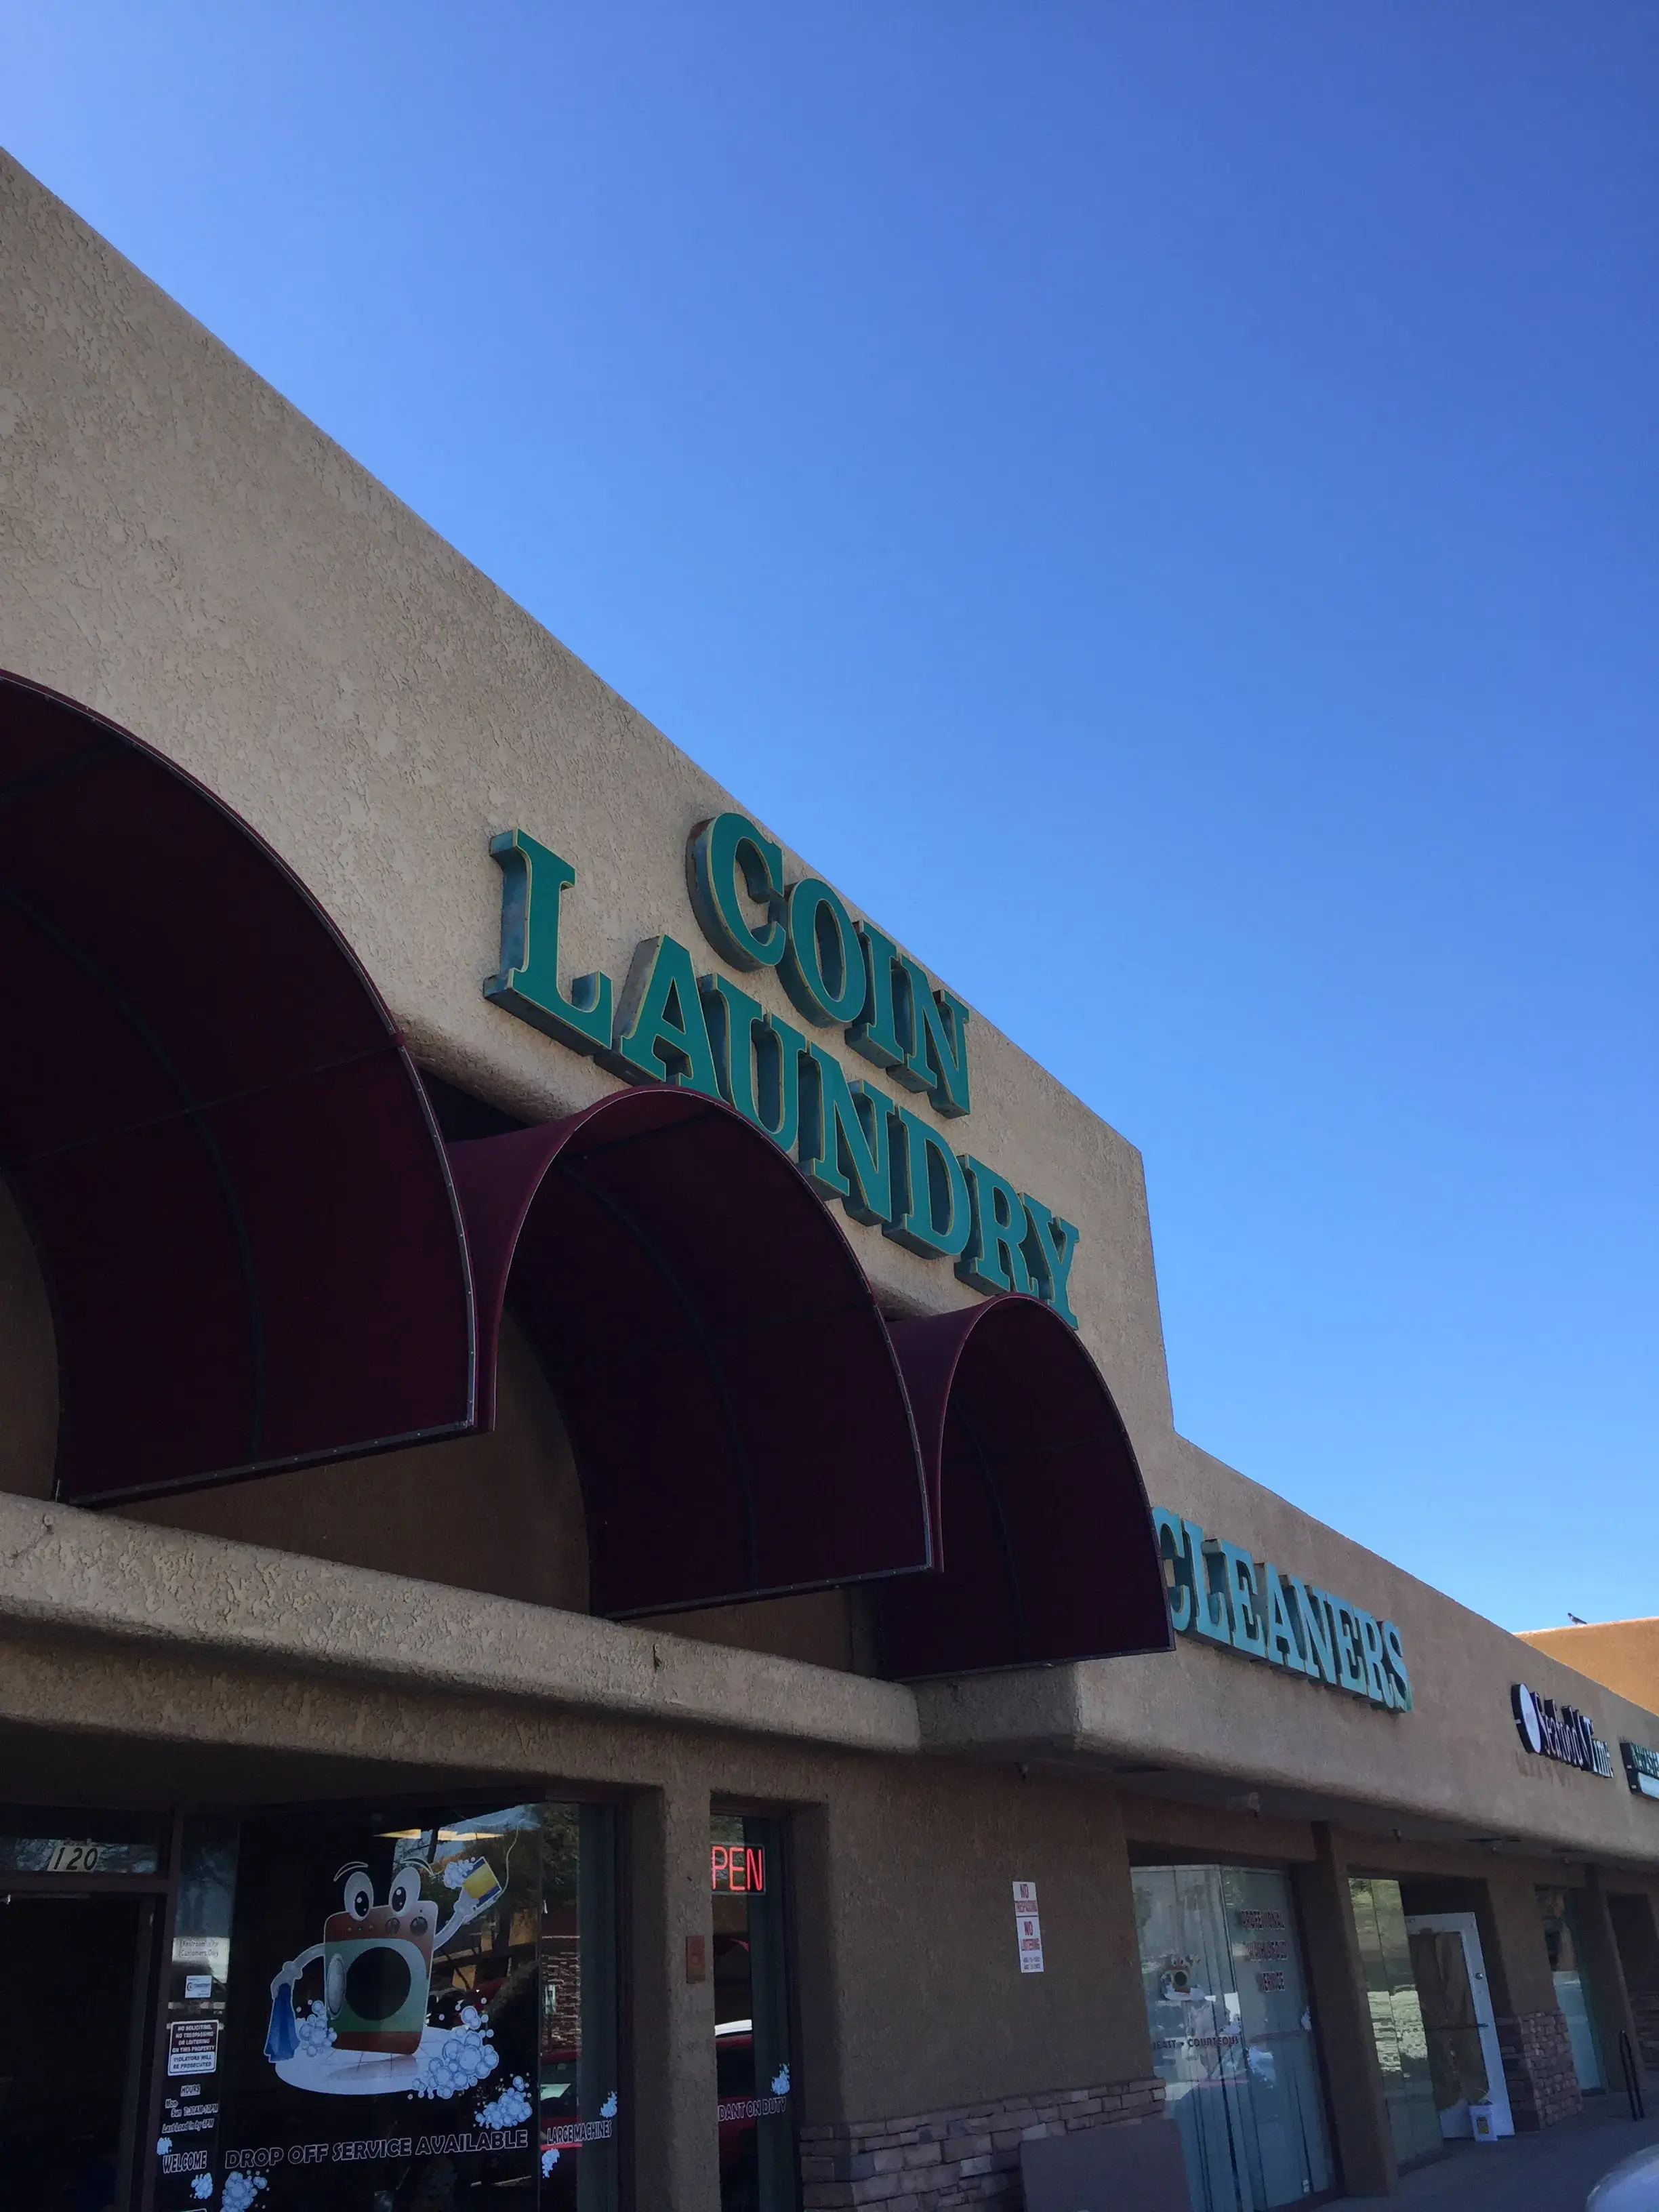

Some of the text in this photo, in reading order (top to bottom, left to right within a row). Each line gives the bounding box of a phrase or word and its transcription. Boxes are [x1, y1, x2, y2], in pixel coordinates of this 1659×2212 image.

[687, 813, 970, 1118] COIN
[484, 828, 1080, 1330] LAUNDRY
[1152, 1506, 1412, 1713] CLEANERS
[54, 1847, 98, 1870] 120
[712, 1845, 763, 1891] PEN
[1024, 1921, 1033, 1936] NO
[1187, 2036, 1240, 2047] COURTEOUS
[180, 2084, 201, 2097] HOURS
[717, 2097, 787, 2123] DANT ON DUTY
[573, 2120, 613, 2143] MACHINES
[225, 2129, 529, 2169] DROP OFF SERVICE AVAILABLE
[162, 2150, 207, 2175] WELCOME
